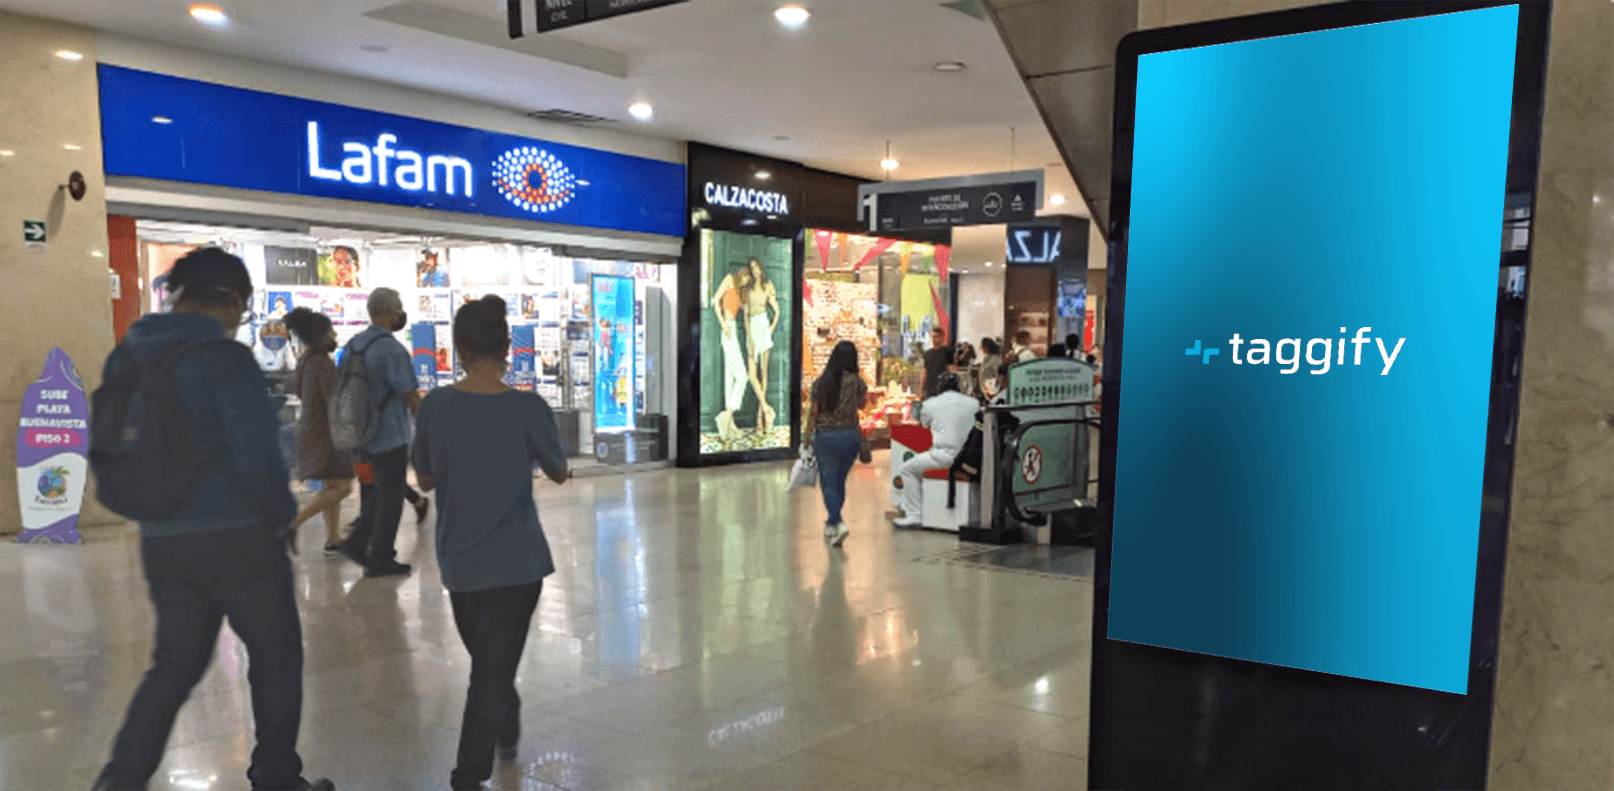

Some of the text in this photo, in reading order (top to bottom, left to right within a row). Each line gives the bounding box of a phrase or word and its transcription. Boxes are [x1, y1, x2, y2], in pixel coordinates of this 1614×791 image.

[307, 120, 474, 198] Lafam
[704, 182, 789, 215] CALZACOSTA
[864, 192, 877, 232] 1
[1229, 326, 1406, 376] taggify
[40, 389, 69, 400] SUBE
[36, 403, 71, 414] PLAYA
[20, 417, 87, 429] BUENAVISTA
[35, 433, 62, 444] PISO
